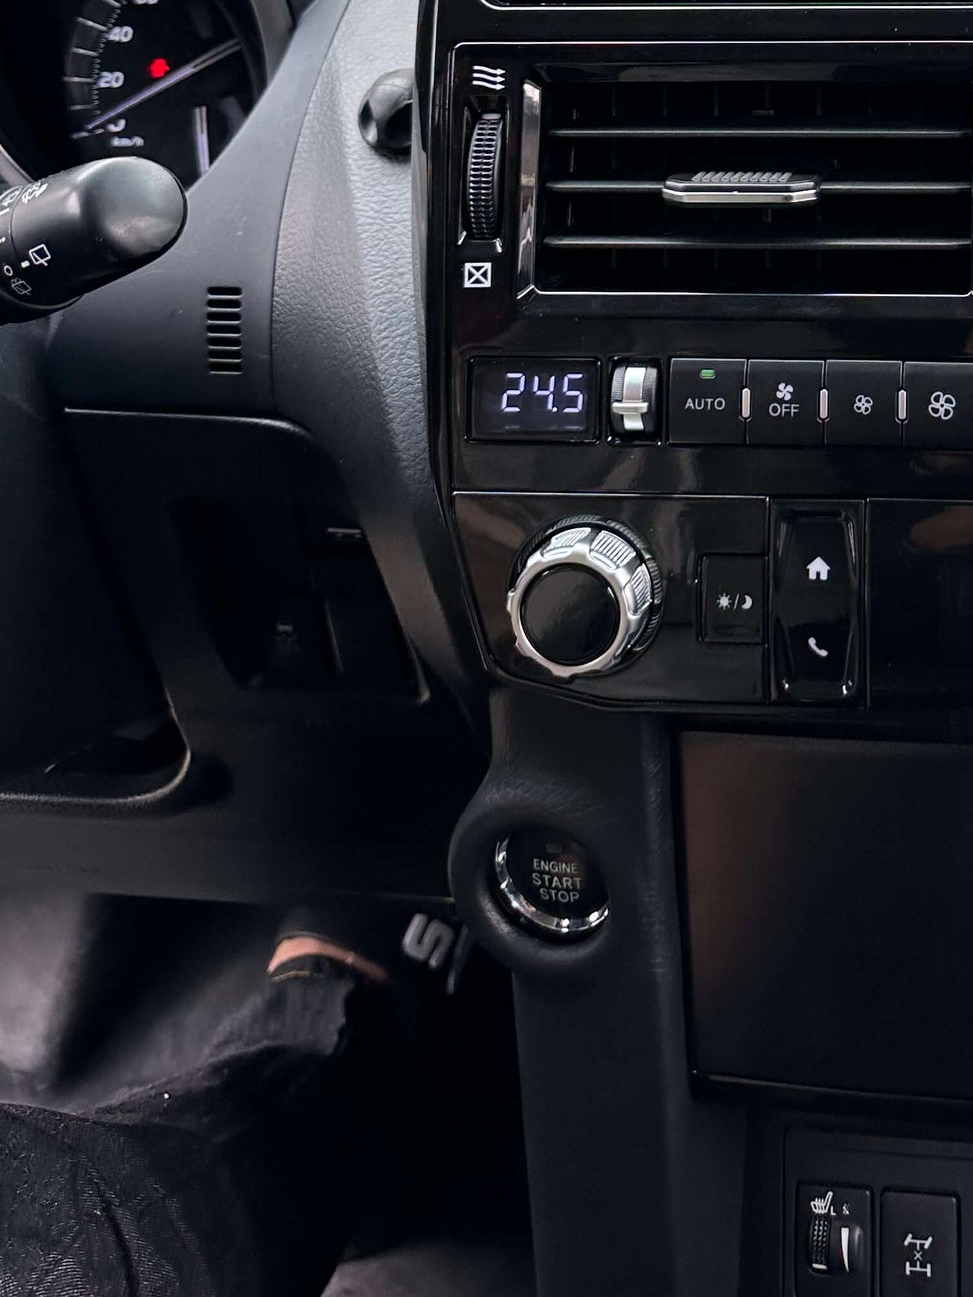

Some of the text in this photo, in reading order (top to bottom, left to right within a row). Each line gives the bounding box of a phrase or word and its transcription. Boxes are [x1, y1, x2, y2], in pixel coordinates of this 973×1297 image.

[106, 26, 134, 43] 40
[98, 71, 125, 89] 20
[501, 373, 584, 413] 24.5
[685, 397, 725, 411] AUTO
[769, 402, 800, 418] OFF
[533, 858, 578, 873] ENGINE
[532, 873, 582, 888] START
[539, 888, 580, 902] STOP
[830, 1205, 837, 1216] L
